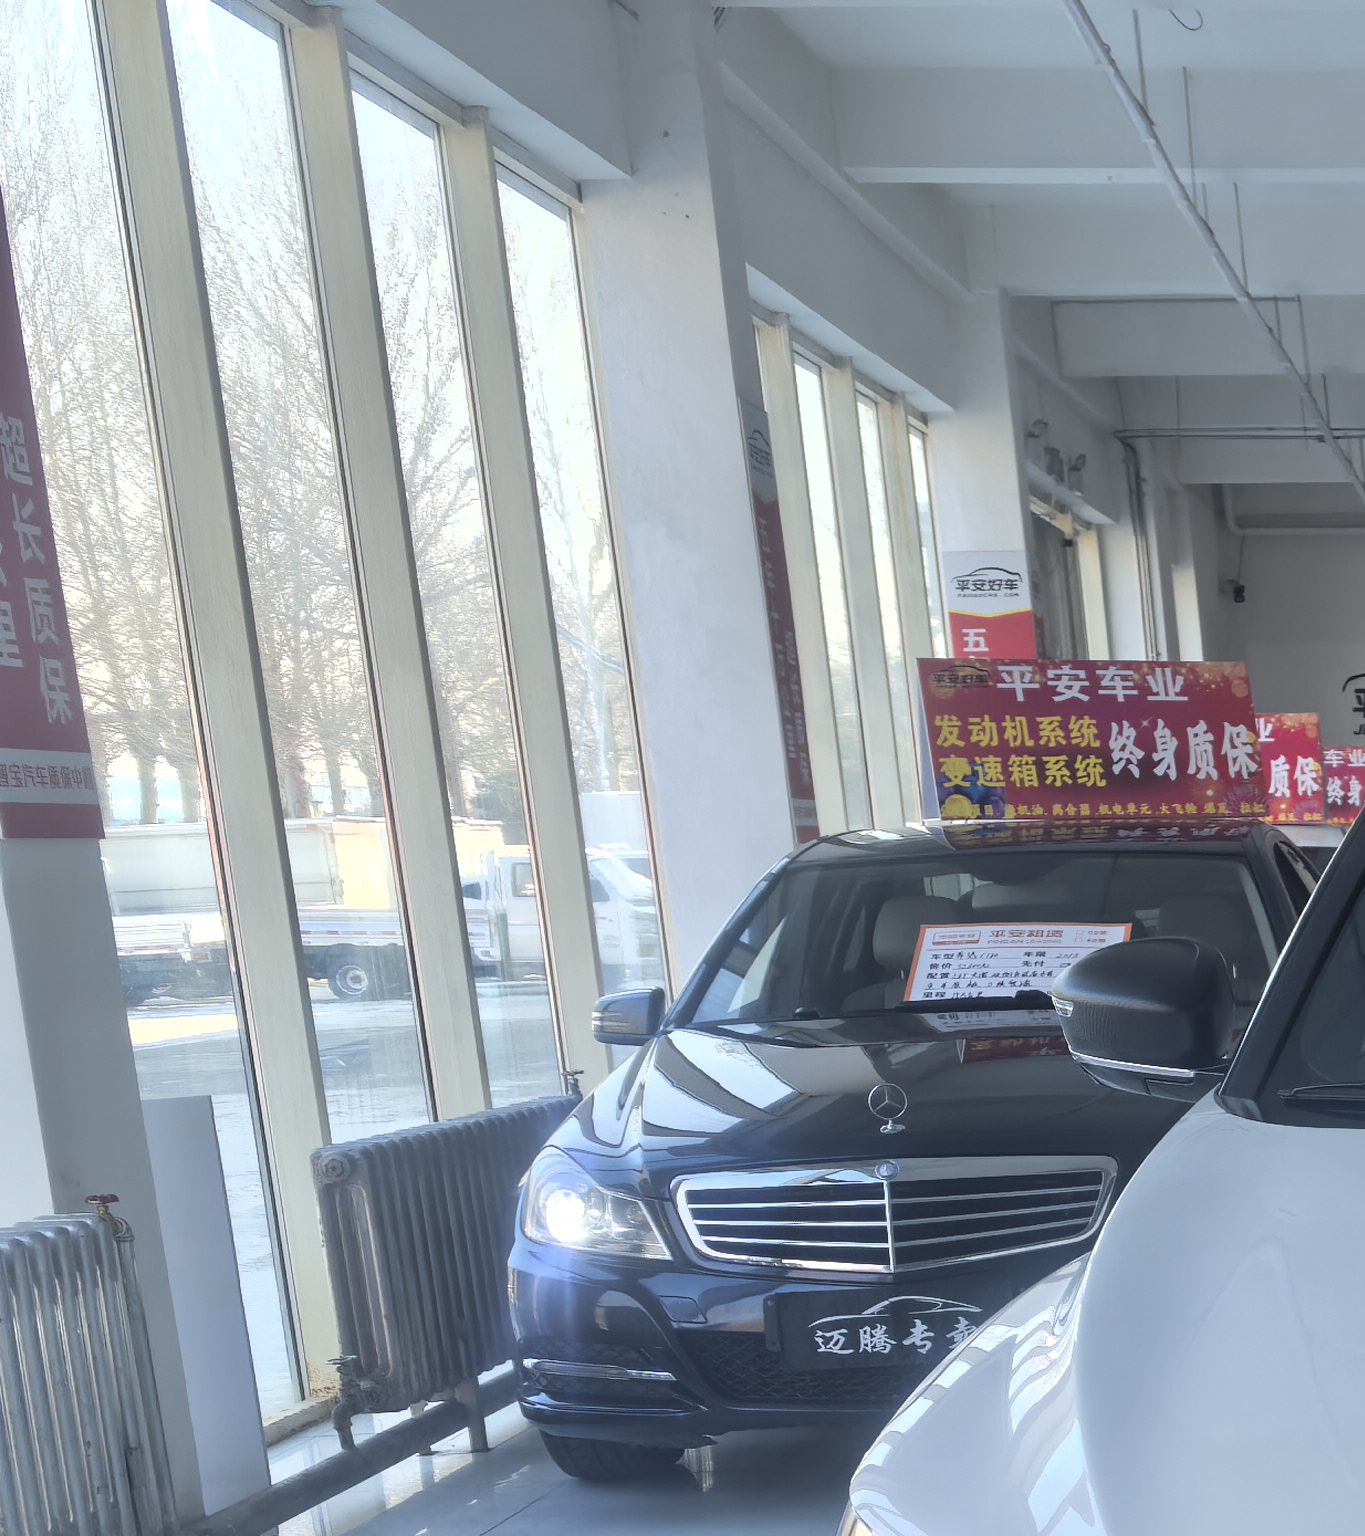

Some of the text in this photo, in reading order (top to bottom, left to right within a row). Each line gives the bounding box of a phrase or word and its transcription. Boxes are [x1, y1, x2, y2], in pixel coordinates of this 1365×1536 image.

[955, 579, 1019, 591] 平安好车
[996, 665, 1189, 702] 平安车业
[934, 714, 1101, 749] 发动机系统
[1108, 718, 1260, 782] 终身质保
[940, 755, 1108, 789] 变速箱系统
[1268, 754, 1320, 798] 质保
